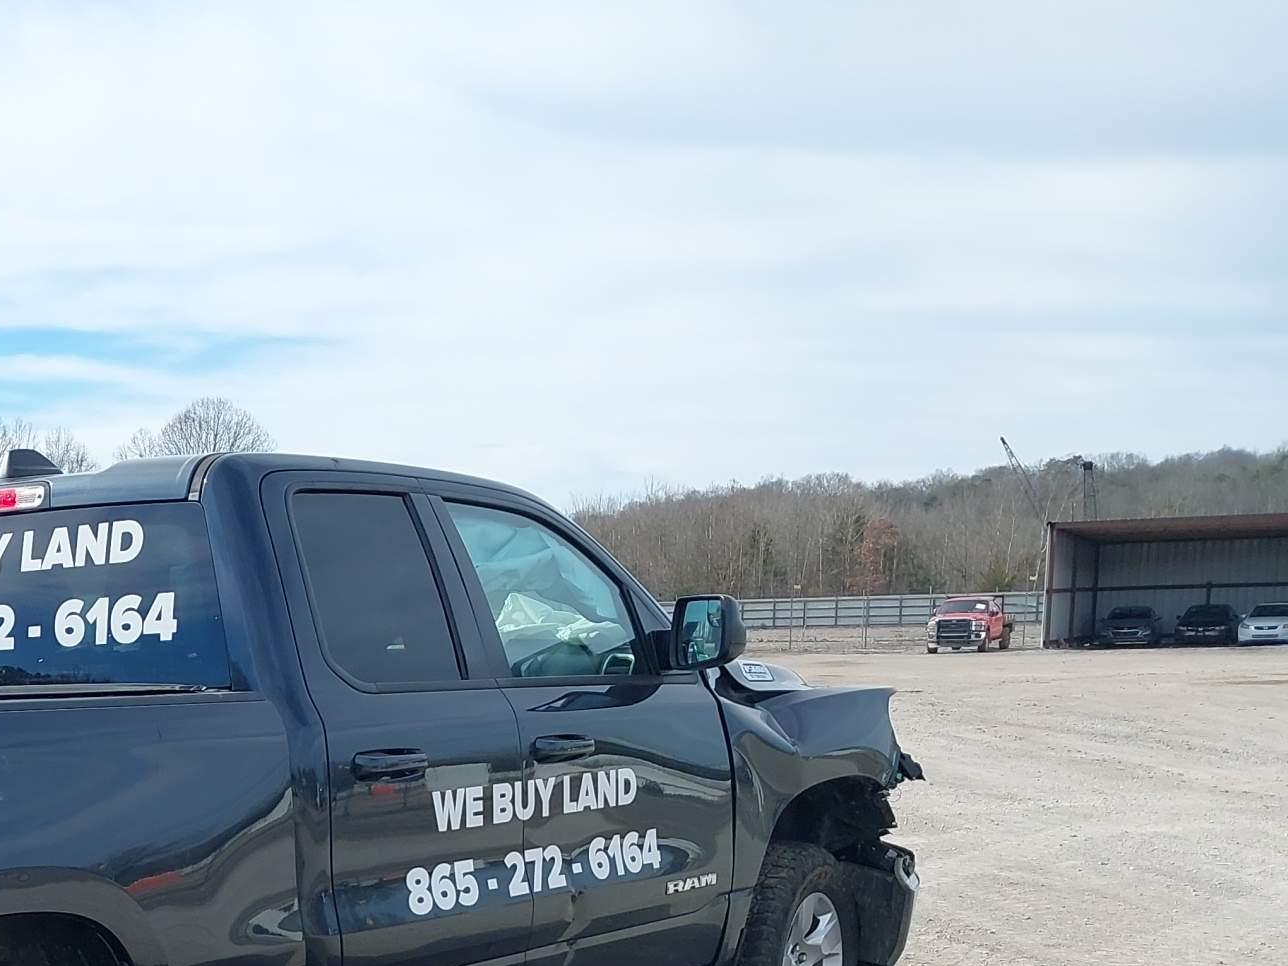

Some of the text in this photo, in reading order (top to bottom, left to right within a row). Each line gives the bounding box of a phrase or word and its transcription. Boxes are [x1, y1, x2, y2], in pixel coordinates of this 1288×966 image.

[20, 519, 144, 573] LAND
[54, 591, 178, 648] 6164
[431, 767, 637, 832] WE BUY LAND
[406, 858, 480, 916] 865
[503, 844, 568, 897] 272
[588, 828, 662, 880] 6164
[666, 872, 718, 895] RAM
